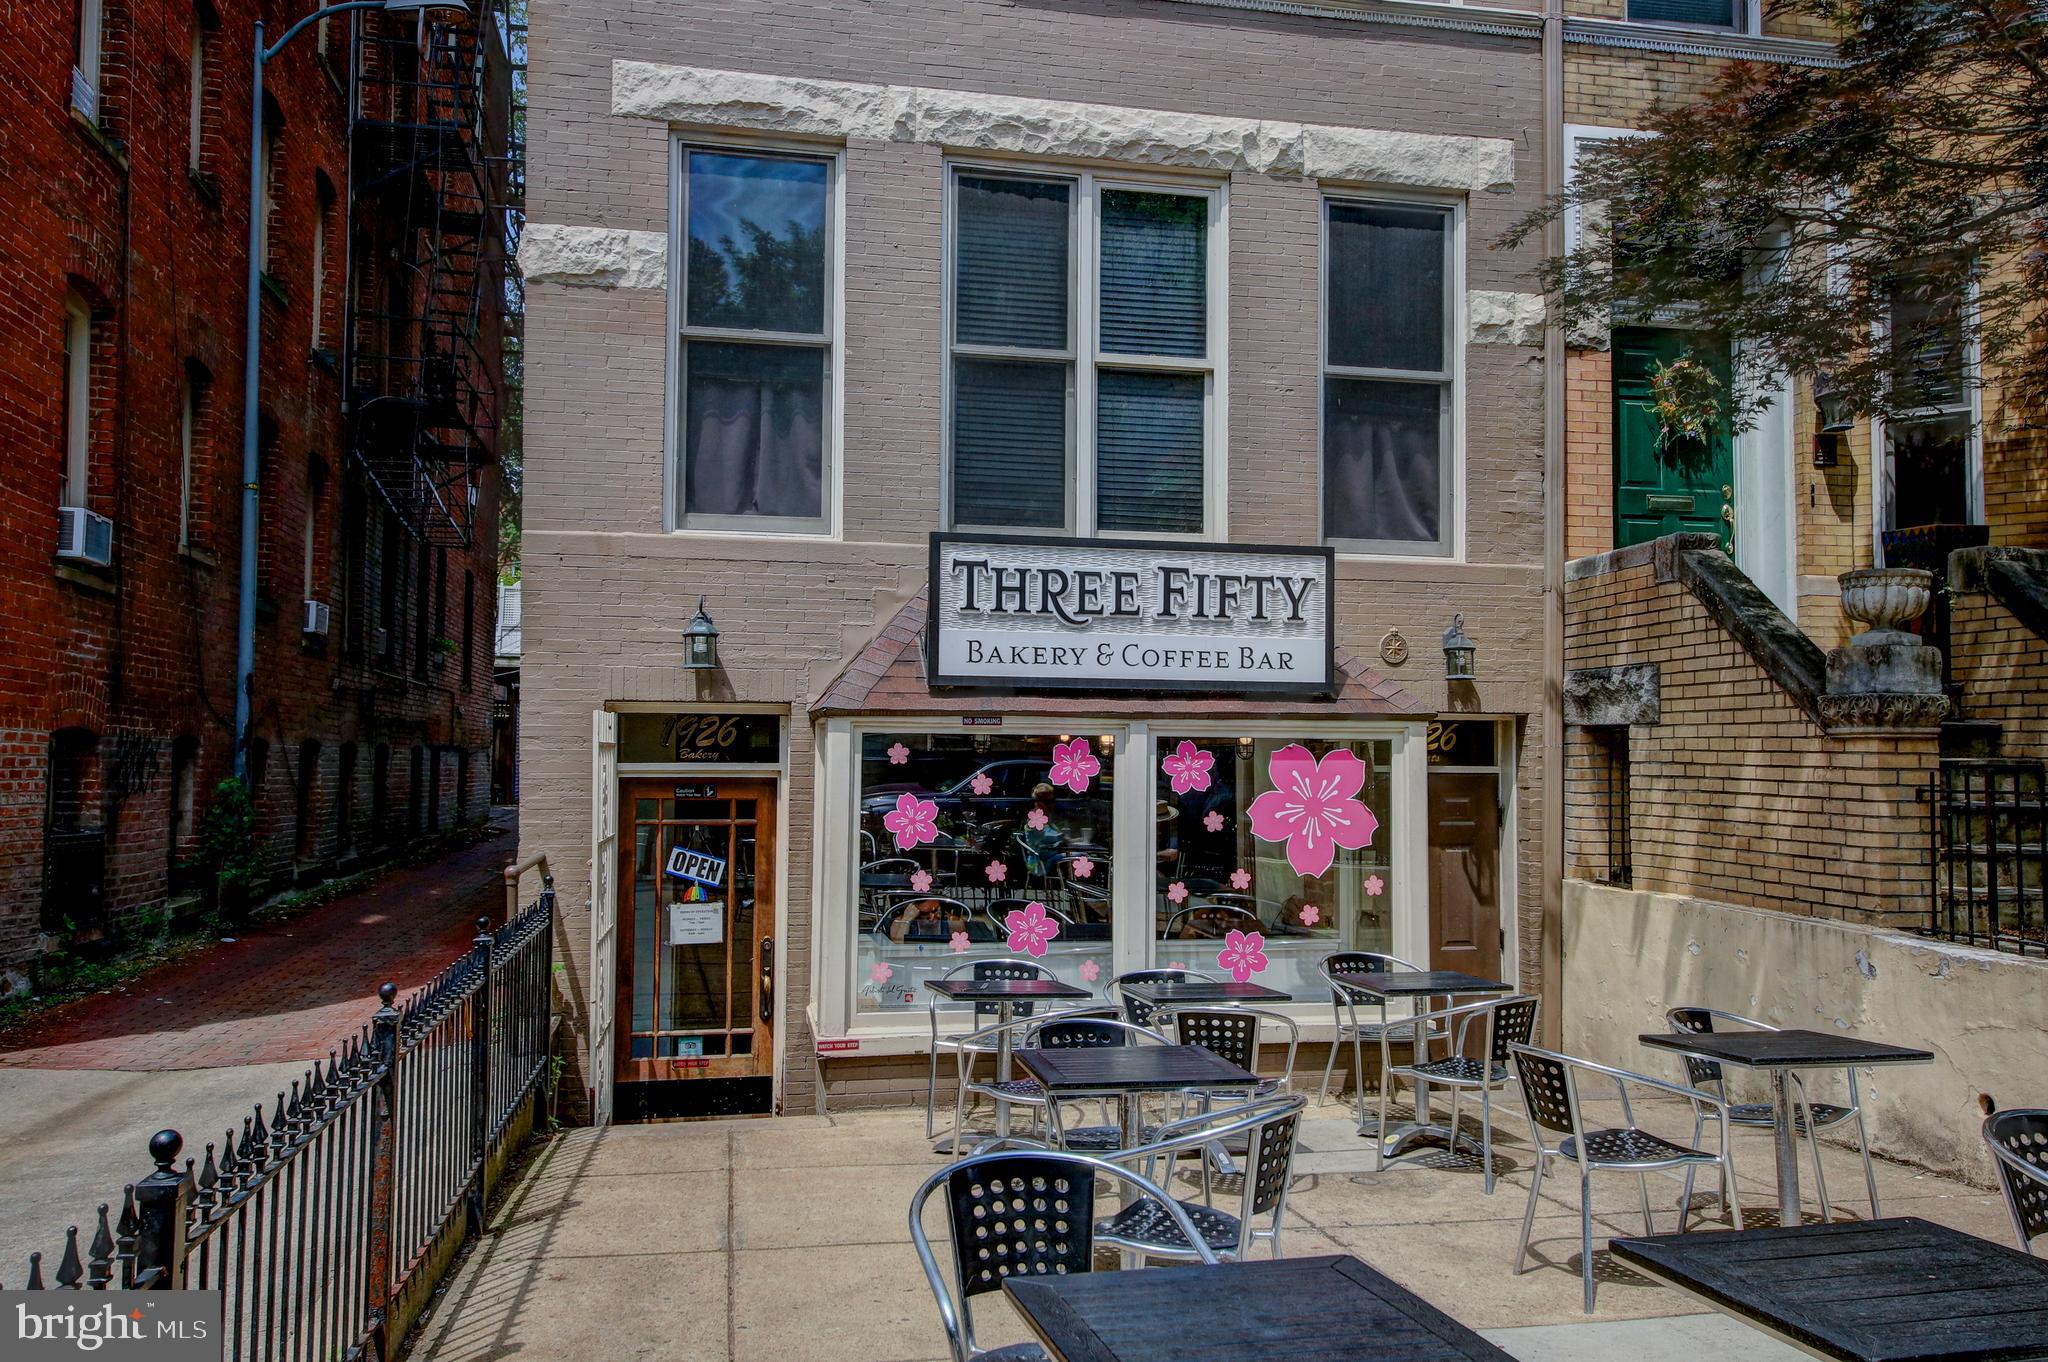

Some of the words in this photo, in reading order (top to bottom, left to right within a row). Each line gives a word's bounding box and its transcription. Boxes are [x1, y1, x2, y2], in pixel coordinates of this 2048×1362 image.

[952, 558, 1141, 625] THREE
[1156, 566, 1316, 621] FIFTY
[966, 639, 1088, 666] BAKERY
[1096, 642, 1115, 667] &
[1121, 643, 1230, 668] COFFEE
[1238, 646, 1295, 670] BAR
[662, 715, 740, 747] 1926
[963, 717, 973, 725] NO
[974, 717, 1001, 725] SMOKING
[679, 748, 720, 761] Bakery
[672, 851, 722, 882] OPEN
